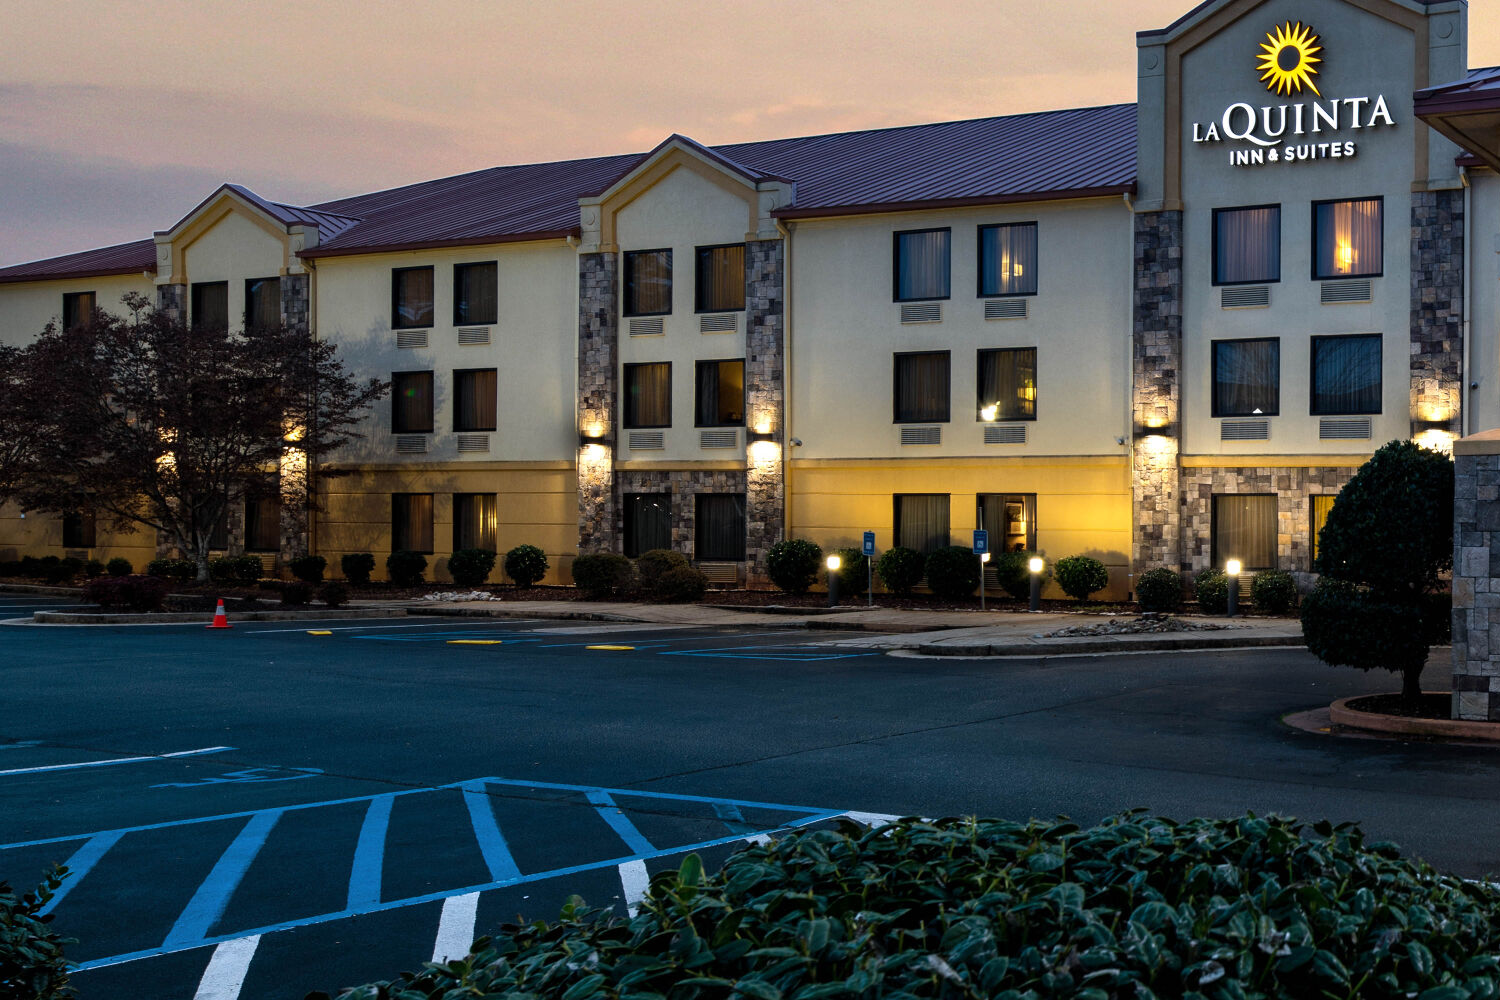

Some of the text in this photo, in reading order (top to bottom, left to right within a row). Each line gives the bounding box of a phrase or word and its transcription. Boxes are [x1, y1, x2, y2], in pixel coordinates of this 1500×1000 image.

[1193, 94, 1395, 146] LA QUINTA
[1229, 140, 1355, 166] INN & SUITES
